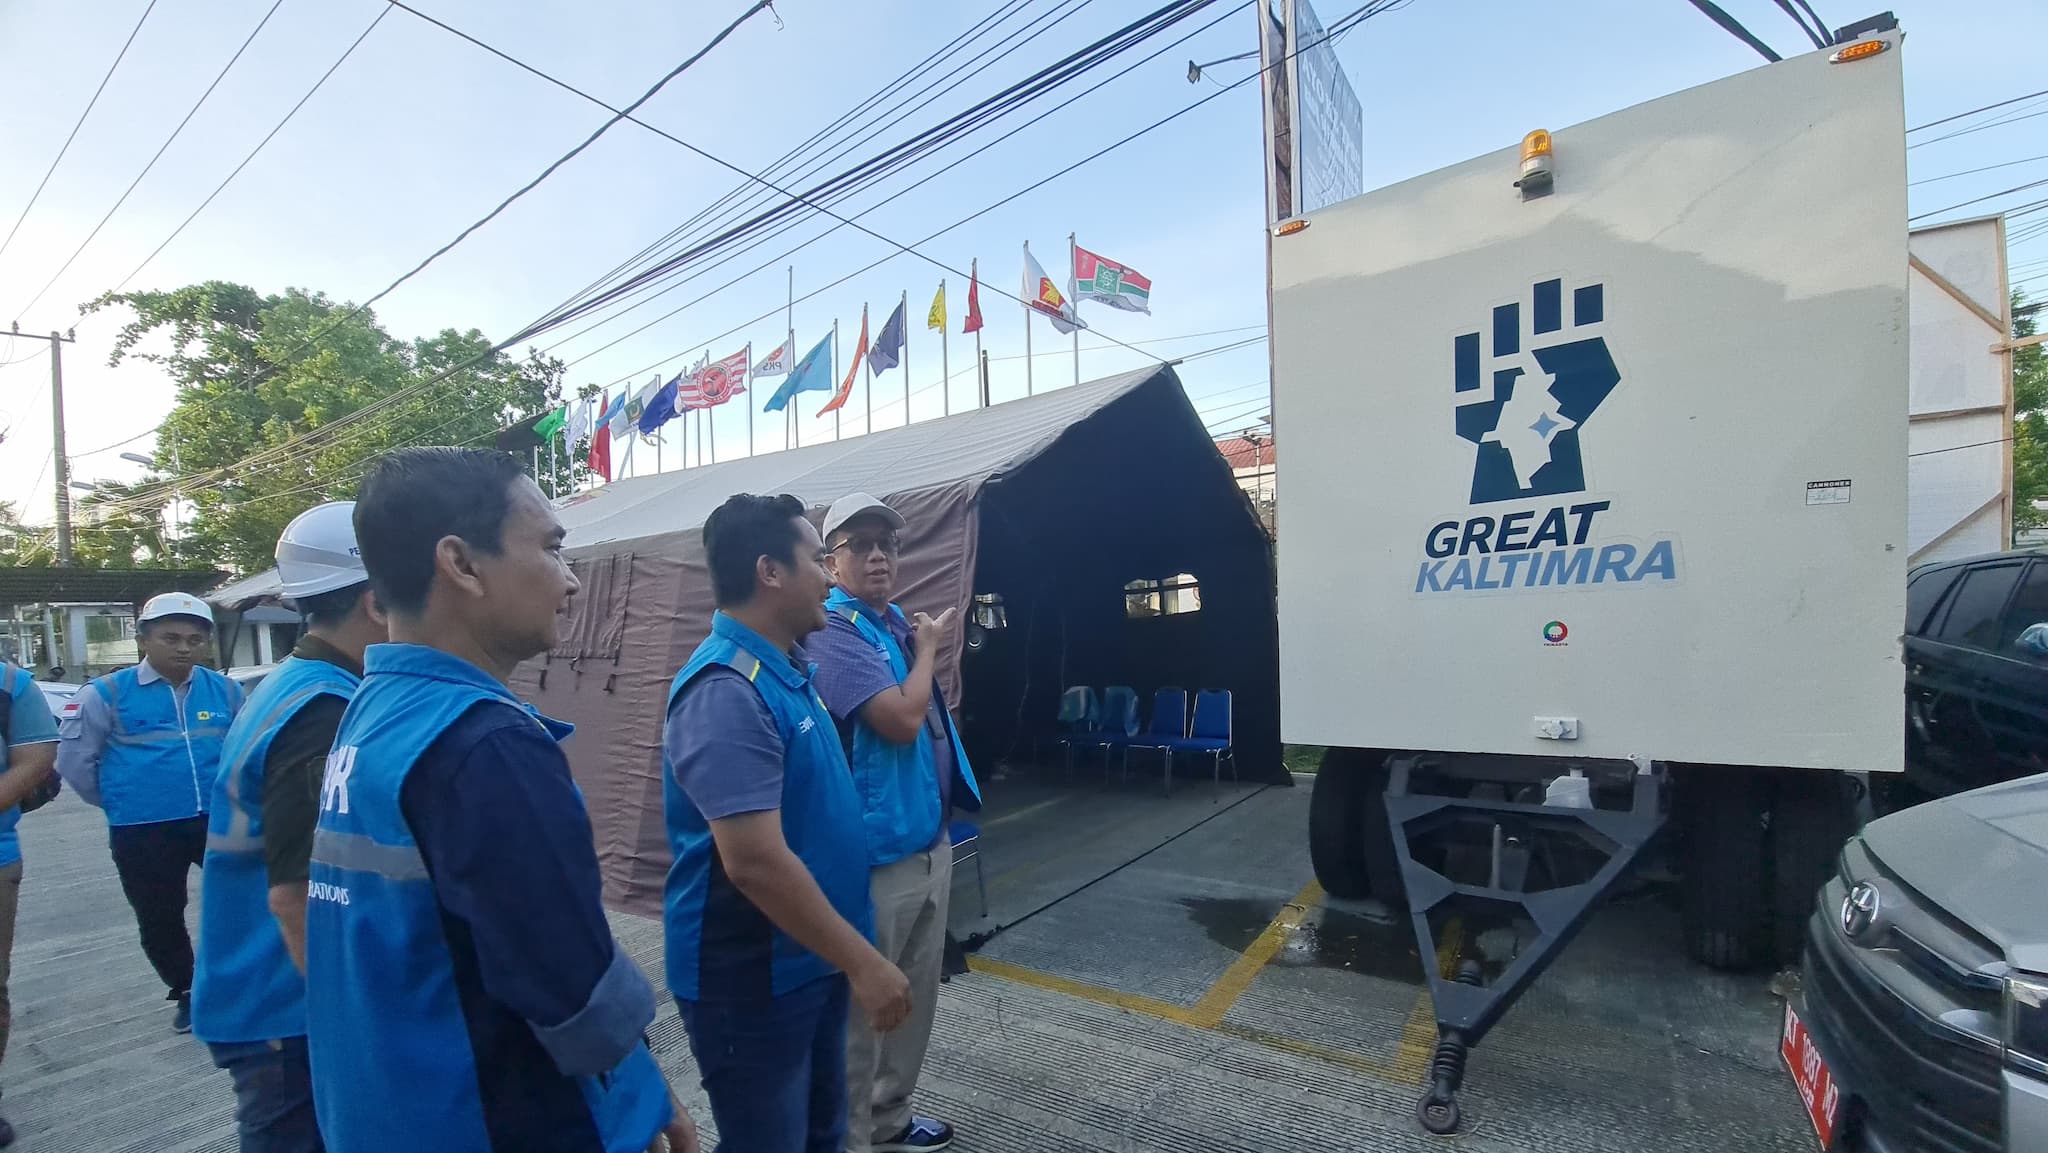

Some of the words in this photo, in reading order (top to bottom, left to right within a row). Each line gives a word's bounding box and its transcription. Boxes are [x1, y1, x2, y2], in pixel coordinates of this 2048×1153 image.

[1425, 501, 1611, 558] GREAT
[1415, 540, 1676, 592] KALTIMRA
[308, 880, 350, 905] RATIONS
